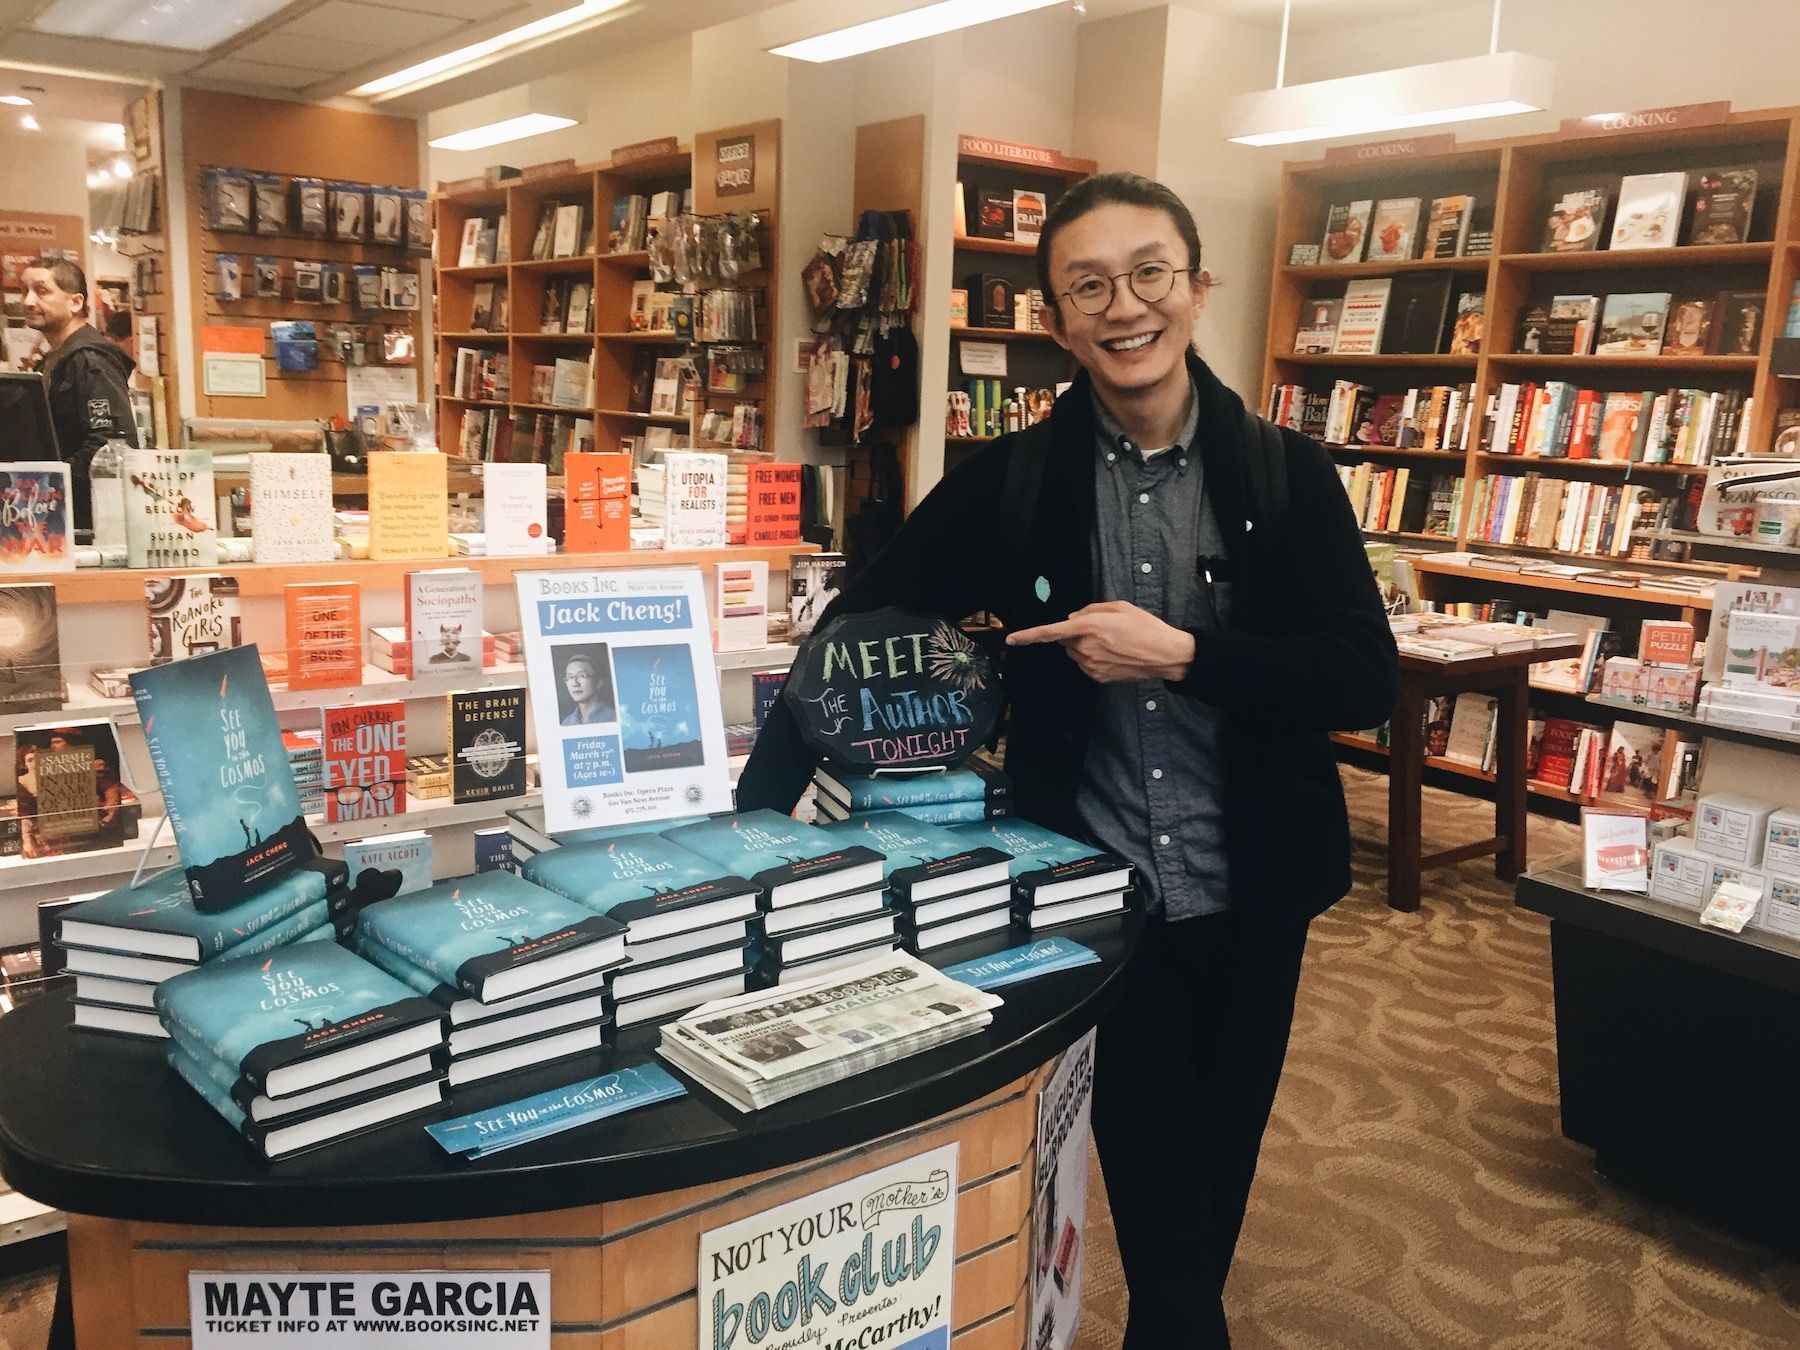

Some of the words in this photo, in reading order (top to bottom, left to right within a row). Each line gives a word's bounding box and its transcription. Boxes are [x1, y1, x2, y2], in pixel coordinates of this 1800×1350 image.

[1602, 110, 1678, 130] COOKING
[962, 138, 992, 152] FOOD
[994, 144, 1054, 163] LITERATURE
[1357, 141, 1415, 159] COOKING
[156, 455, 180, 464] THE
[142, 472, 172, 481] FALL
[179, 472, 196, 481] OF
[682, 473, 714, 485] UTOPIA
[755, 471, 773, 483] FREE
[774, 470, 801, 483] WOMEN
[263, 489, 325, 499] HIMSELF
[689, 486, 707, 498] FOR
[759, 493, 776, 505] FREE
[779, 492, 796, 505] MEN
[680, 500, 716, 510] REALISTS
[150, 532, 194, 541] SUSAN
[147, 548, 200, 558] PERABO
[812, 560, 847, 568] HARRISON
[425, 585, 466, 593] Generation
[417, 594, 477, 607] Sociopaths
[172, 598, 225, 632] ROANOKE
[312, 610, 337, 622] ONE
[545, 602, 600, 630] Jack
[607, 599, 682, 624] Cheng!
[1735, 617, 1780, 628] POP-OUT
[182, 615, 223, 648] GIRLS
[304, 631, 323, 640] OF
[325, 630, 347, 639] THE
[1651, 630, 1689, 642] PETIT
[1651, 641, 1688, 652] PUZZLE
[310, 650, 343, 662] BOYS
[822, 633, 929, 682] MEET
[650, 673, 666, 686] SEE
[650, 686, 666, 699] YOU
[458, 701, 478, 711] THE
[485, 697, 520, 709] BRAIN
[641, 701, 677, 714] COSMOS
[809, 688, 848, 718] THE
[220, 708, 241, 732] SEE
[465, 709, 515, 722] DEFENSE
[332, 736, 353, 753] THE
[356, 720, 406, 755] ONE
[851, 728, 969, 760] TONIGHT
[224, 730, 246, 759] YOU
[577, 741, 605, 751] Friday
[46, 752, 85, 764] SARAH
[570, 750, 599, 761] March
[40, 761, 93, 776] DUNANT
[220, 754, 265, 787] COSMOS
[323, 755, 391, 789] EYED
[574, 762, 584, 770] at
[591, 761, 612, 770] p.m.
[574, 770, 597, 780] (Ages
[466, 787, 489, 796] KEVIN
[492, 783, 515, 793] DAVIS
[603, 791, 623, 799] Books
[637, 788, 656, 797] Opera
[338, 789, 395, 821] MAN
[245, 853, 265, 867] JACK
[266, 841, 288, 856] CHENG
[388, 848, 420, 860] ALCOTT
[613, 860, 674, 880] COSMOS
[615, 857, 645, 870] YOU
[454, 897, 485, 911] SEE
[462, 903, 495, 919] YOU
[460, 906, 529, 931] COSMOS
[512, 944, 539, 954] JACK
[966, 967, 990, 977] SEE
[988, 960, 1012, 972] YOU
[1021, 944, 1063, 962] COSMOS
[262, 970, 296, 985] SEE
[267, 978, 304, 996] YOU
[260, 982, 340, 1011] COSMOS
[825, 987, 904, 1013] MARCH
[305, 1027, 337, 1040] JACK
[474, 1119, 506, 1135] SEE
[507, 1108, 538, 1126] YOU
[563, 1082, 623, 1110] COSMOS
[711, 1231, 773, 1282] NOT
[777, 1202, 857, 1254] YOUR
[866, 1185, 944, 1214] Mother's
[712, 1254, 836, 1350] book
[838, 1214, 942, 1306] club
[204, 1282, 356, 1316] MAYTE
[371, 1281, 540, 1316] GARCIA
[206, 1320, 270, 1333] TICKET
[278, 1320, 319, 1333] INFO
[325, 1320, 349, 1332] AT
[353, 1319, 540, 1333] WWW.BOOKSINC.NET
[824, 1294, 942, 1350] McCarthy!
